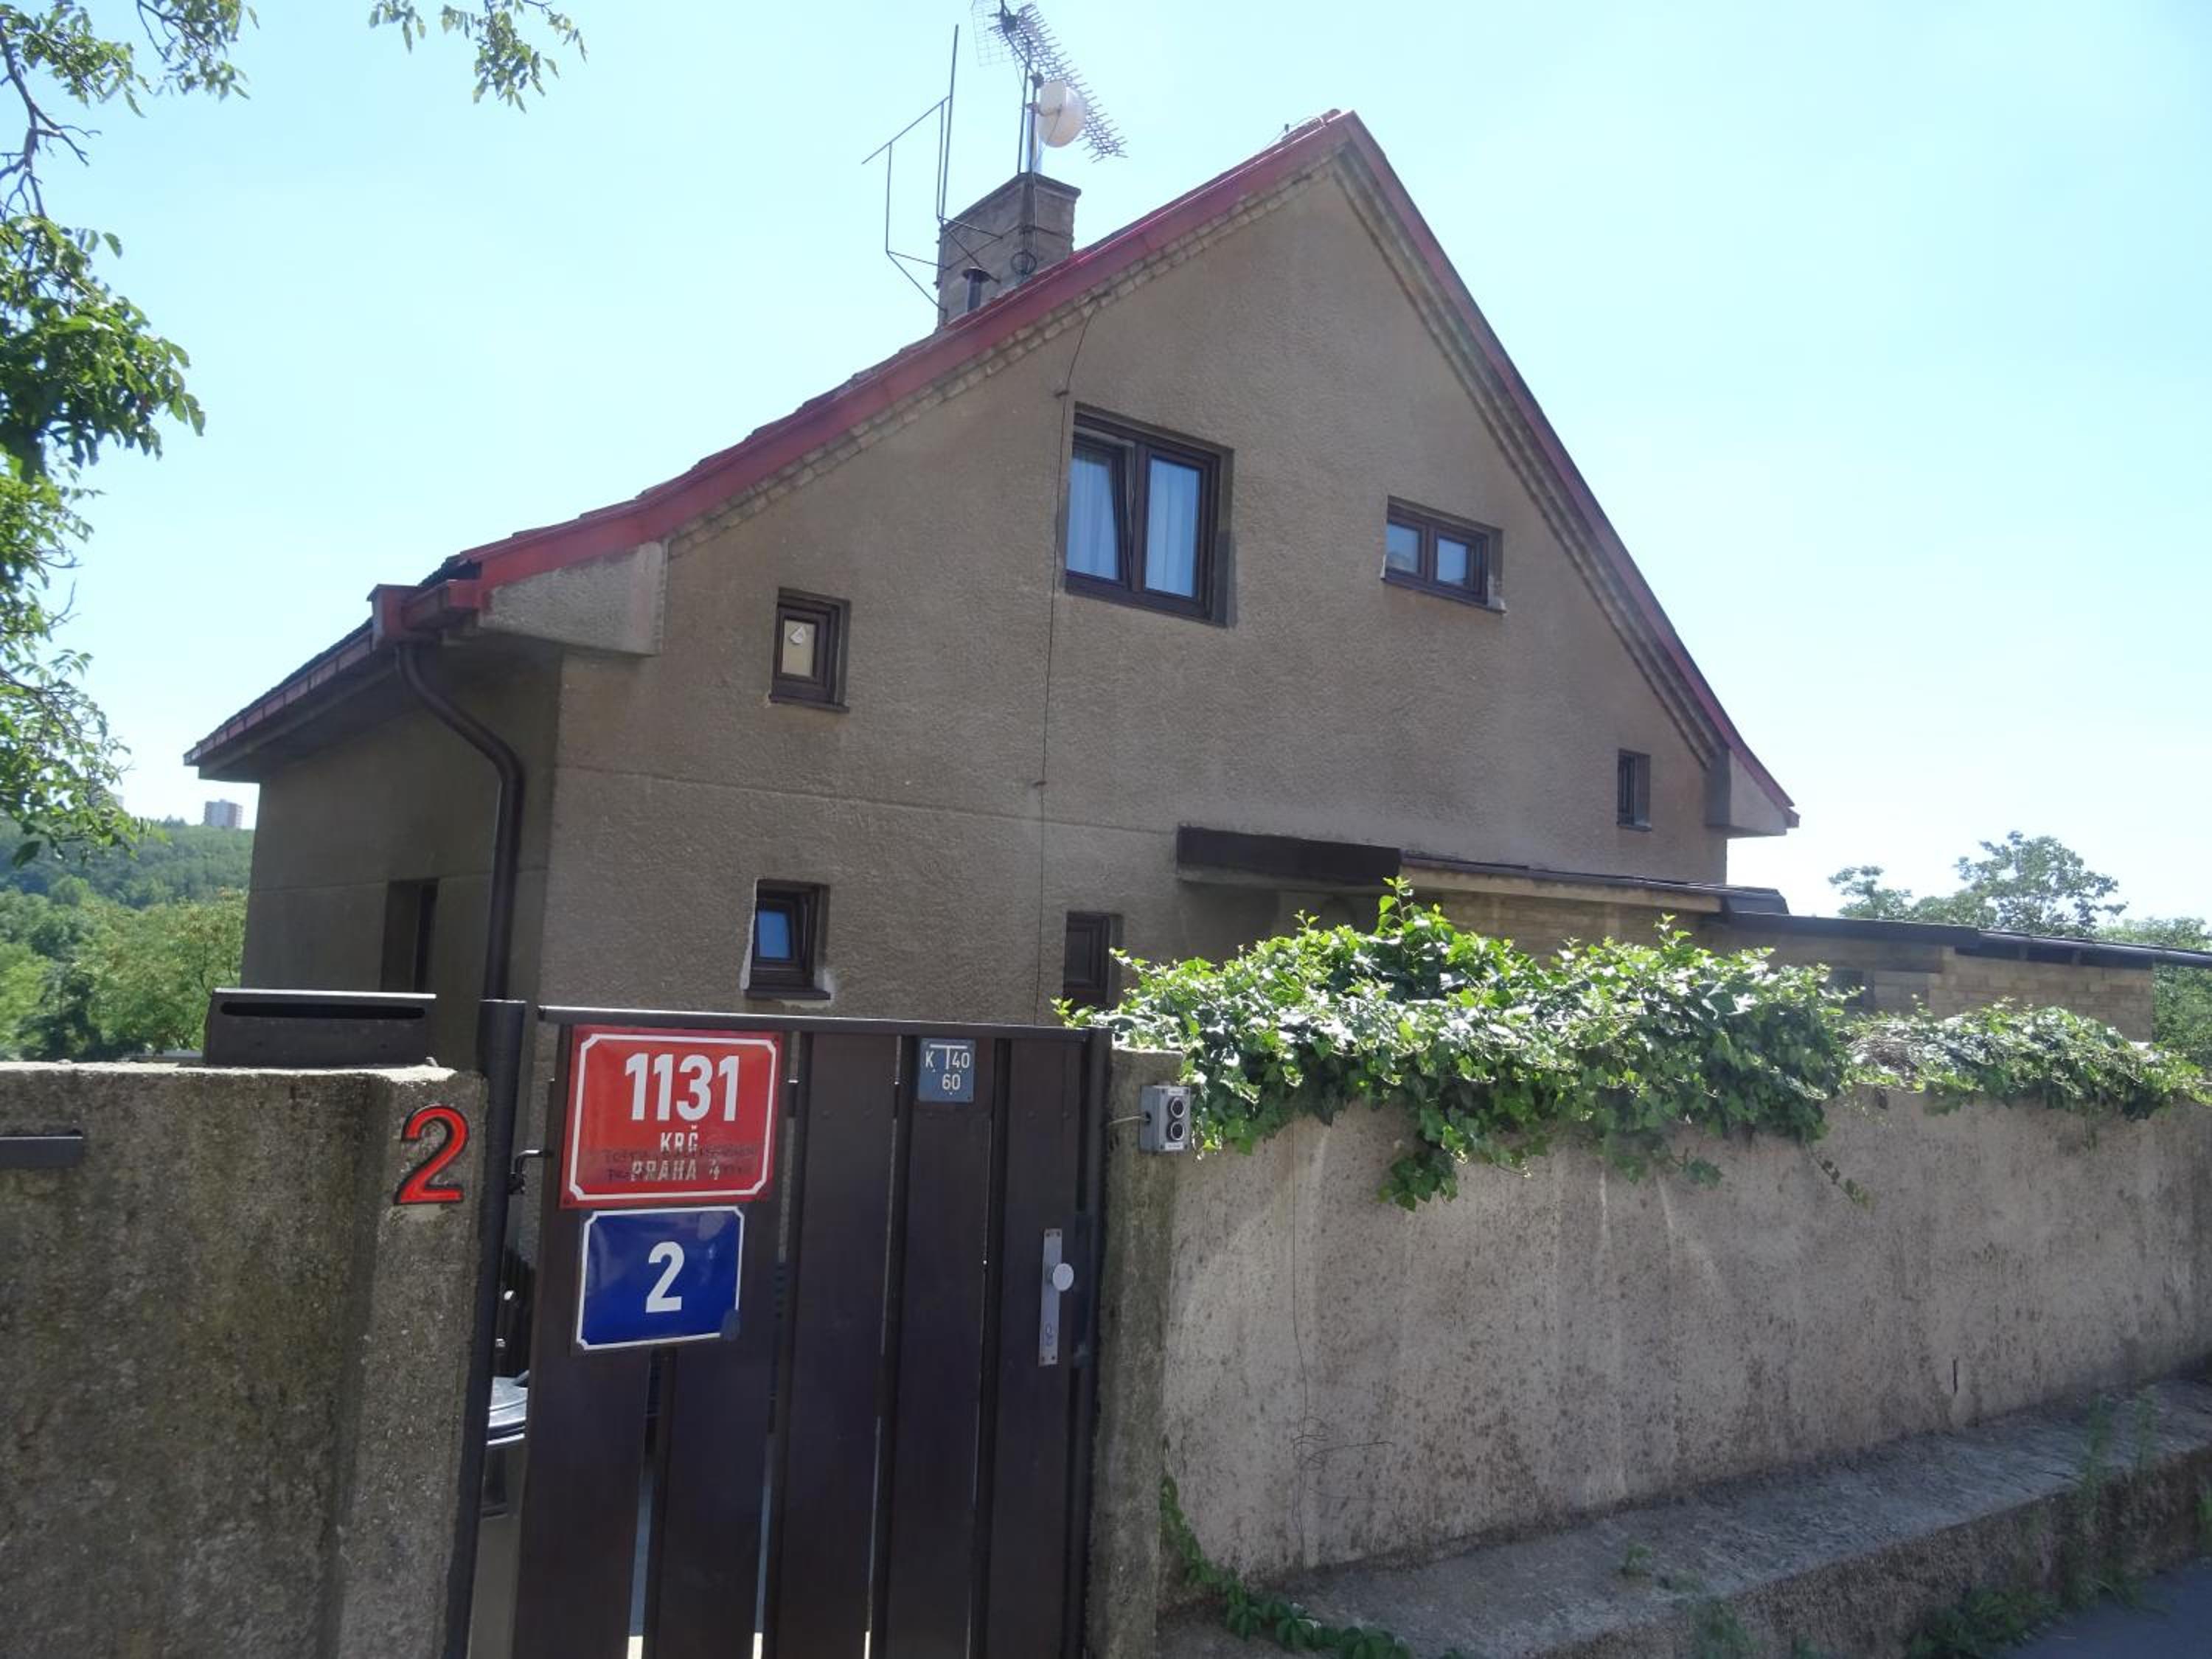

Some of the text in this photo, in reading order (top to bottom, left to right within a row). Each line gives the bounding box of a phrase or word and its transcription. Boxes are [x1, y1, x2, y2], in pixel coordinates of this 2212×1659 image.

[625, 1052, 740, 1121] 1131
[925, 1051, 934, 1068] K
[393, 1104, 470, 1206] 2
[630, 1158, 698, 1182] PRAHA
[645, 1241, 686, 1313] 2
